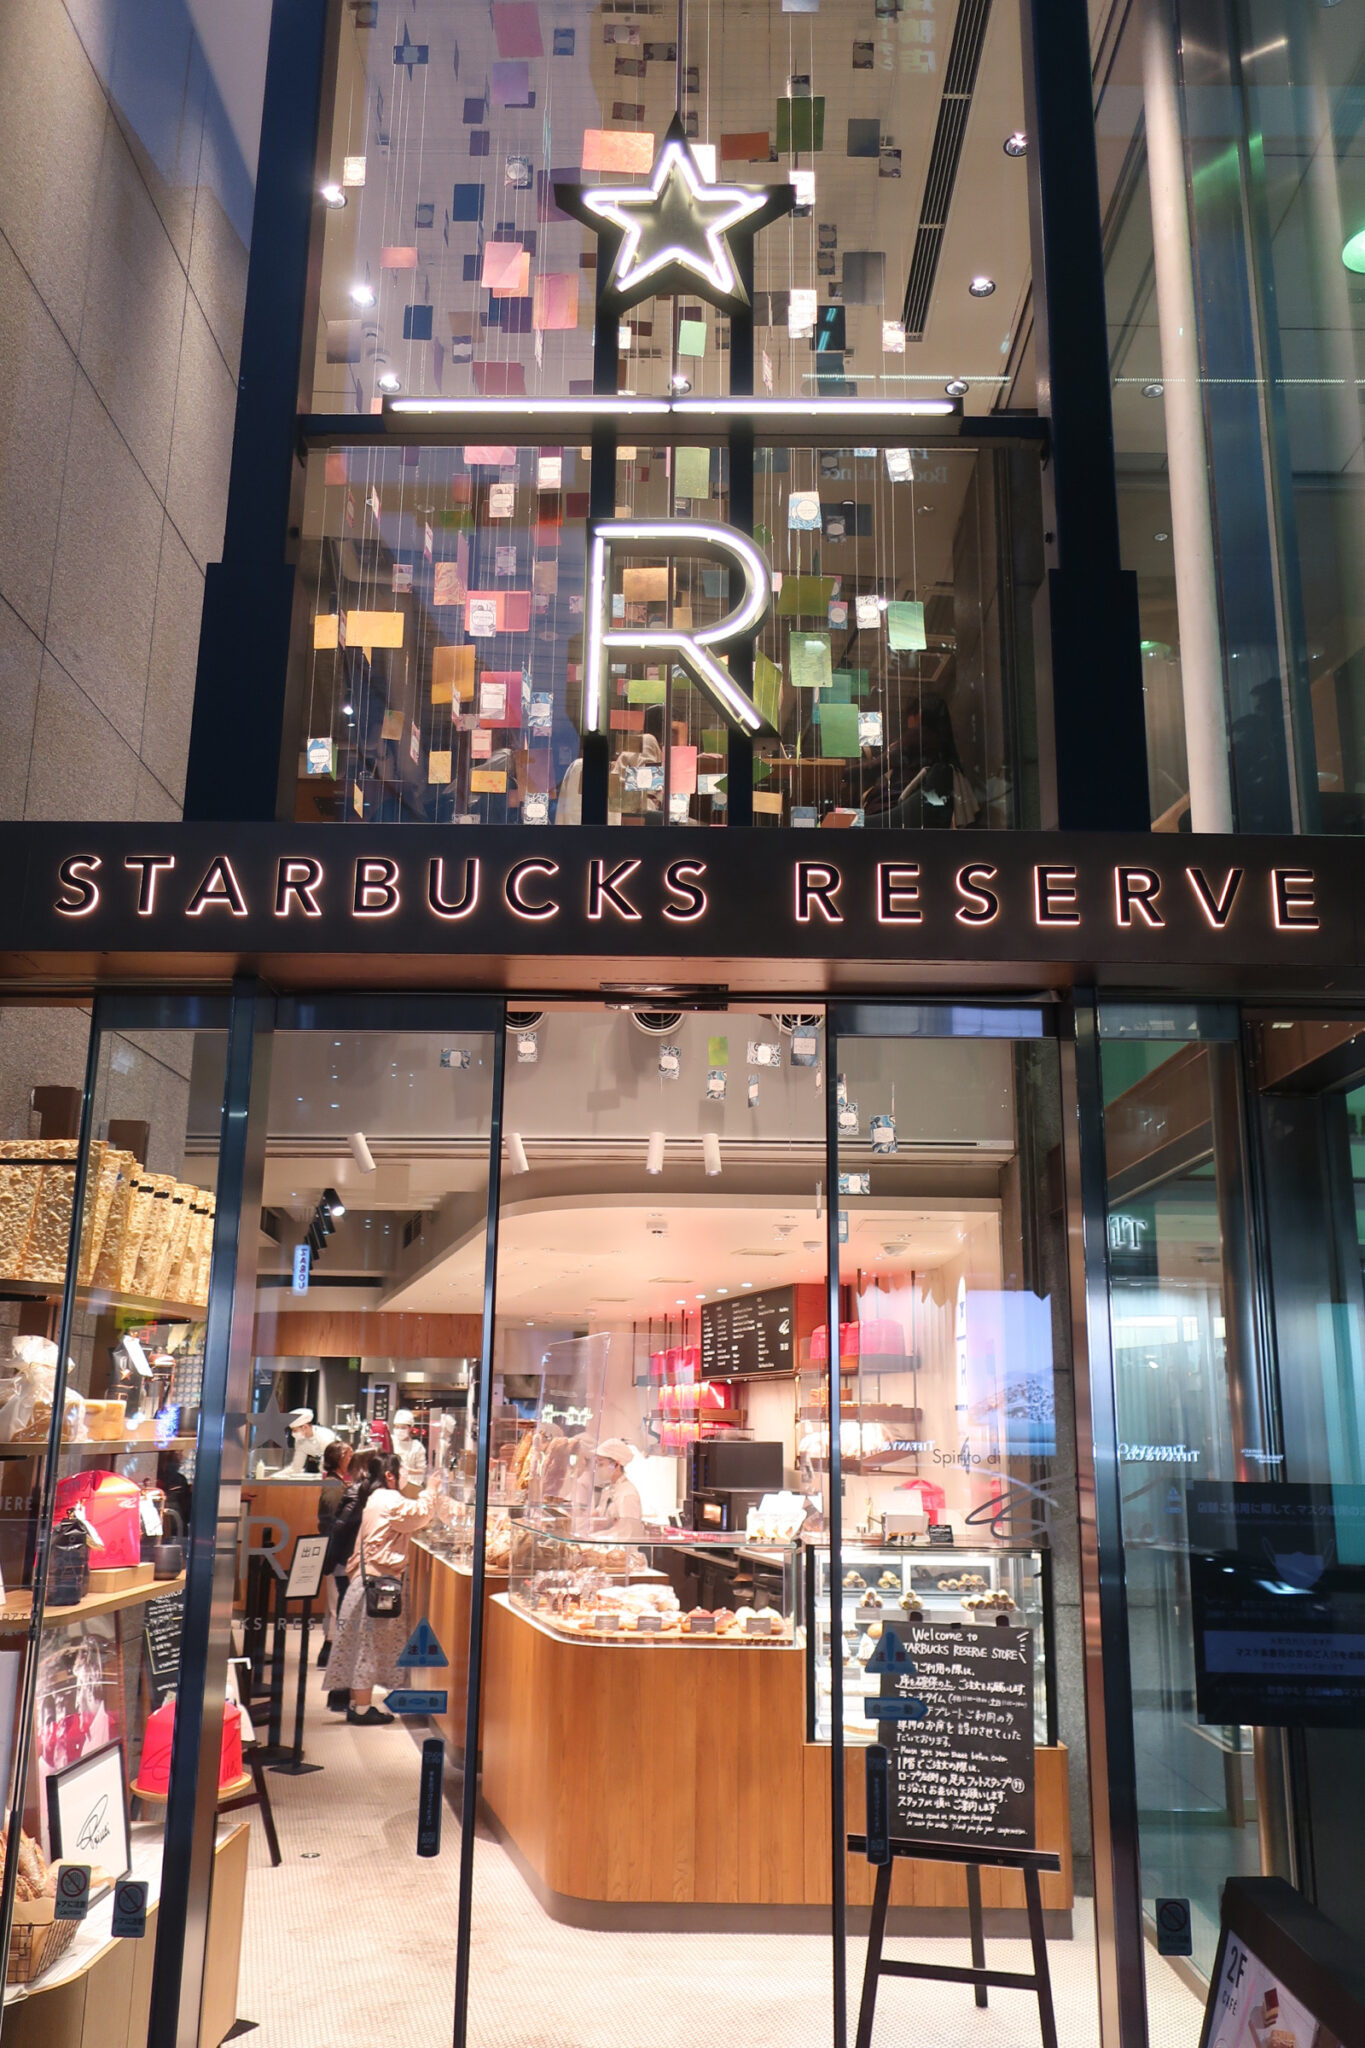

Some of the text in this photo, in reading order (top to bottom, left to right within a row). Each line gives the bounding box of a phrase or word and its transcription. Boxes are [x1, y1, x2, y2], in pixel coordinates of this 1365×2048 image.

[582, 518, 777, 737] R
[53, 854, 1321, 931] STARBUCKS RESERVE
[932, 1448, 981, 1468] Spirito
[987, 1448, 1001, 1465] di
[301, 1545, 321, 1558] 出口
[912, 1627, 979, 1642] Welcome to
[903, 1643, 1018, 1661] TARBUCKS RESERVE STORE
[912, 1661, 976, 1677] ご利用の際は、
[1226, 1945, 1248, 1988] 2F
